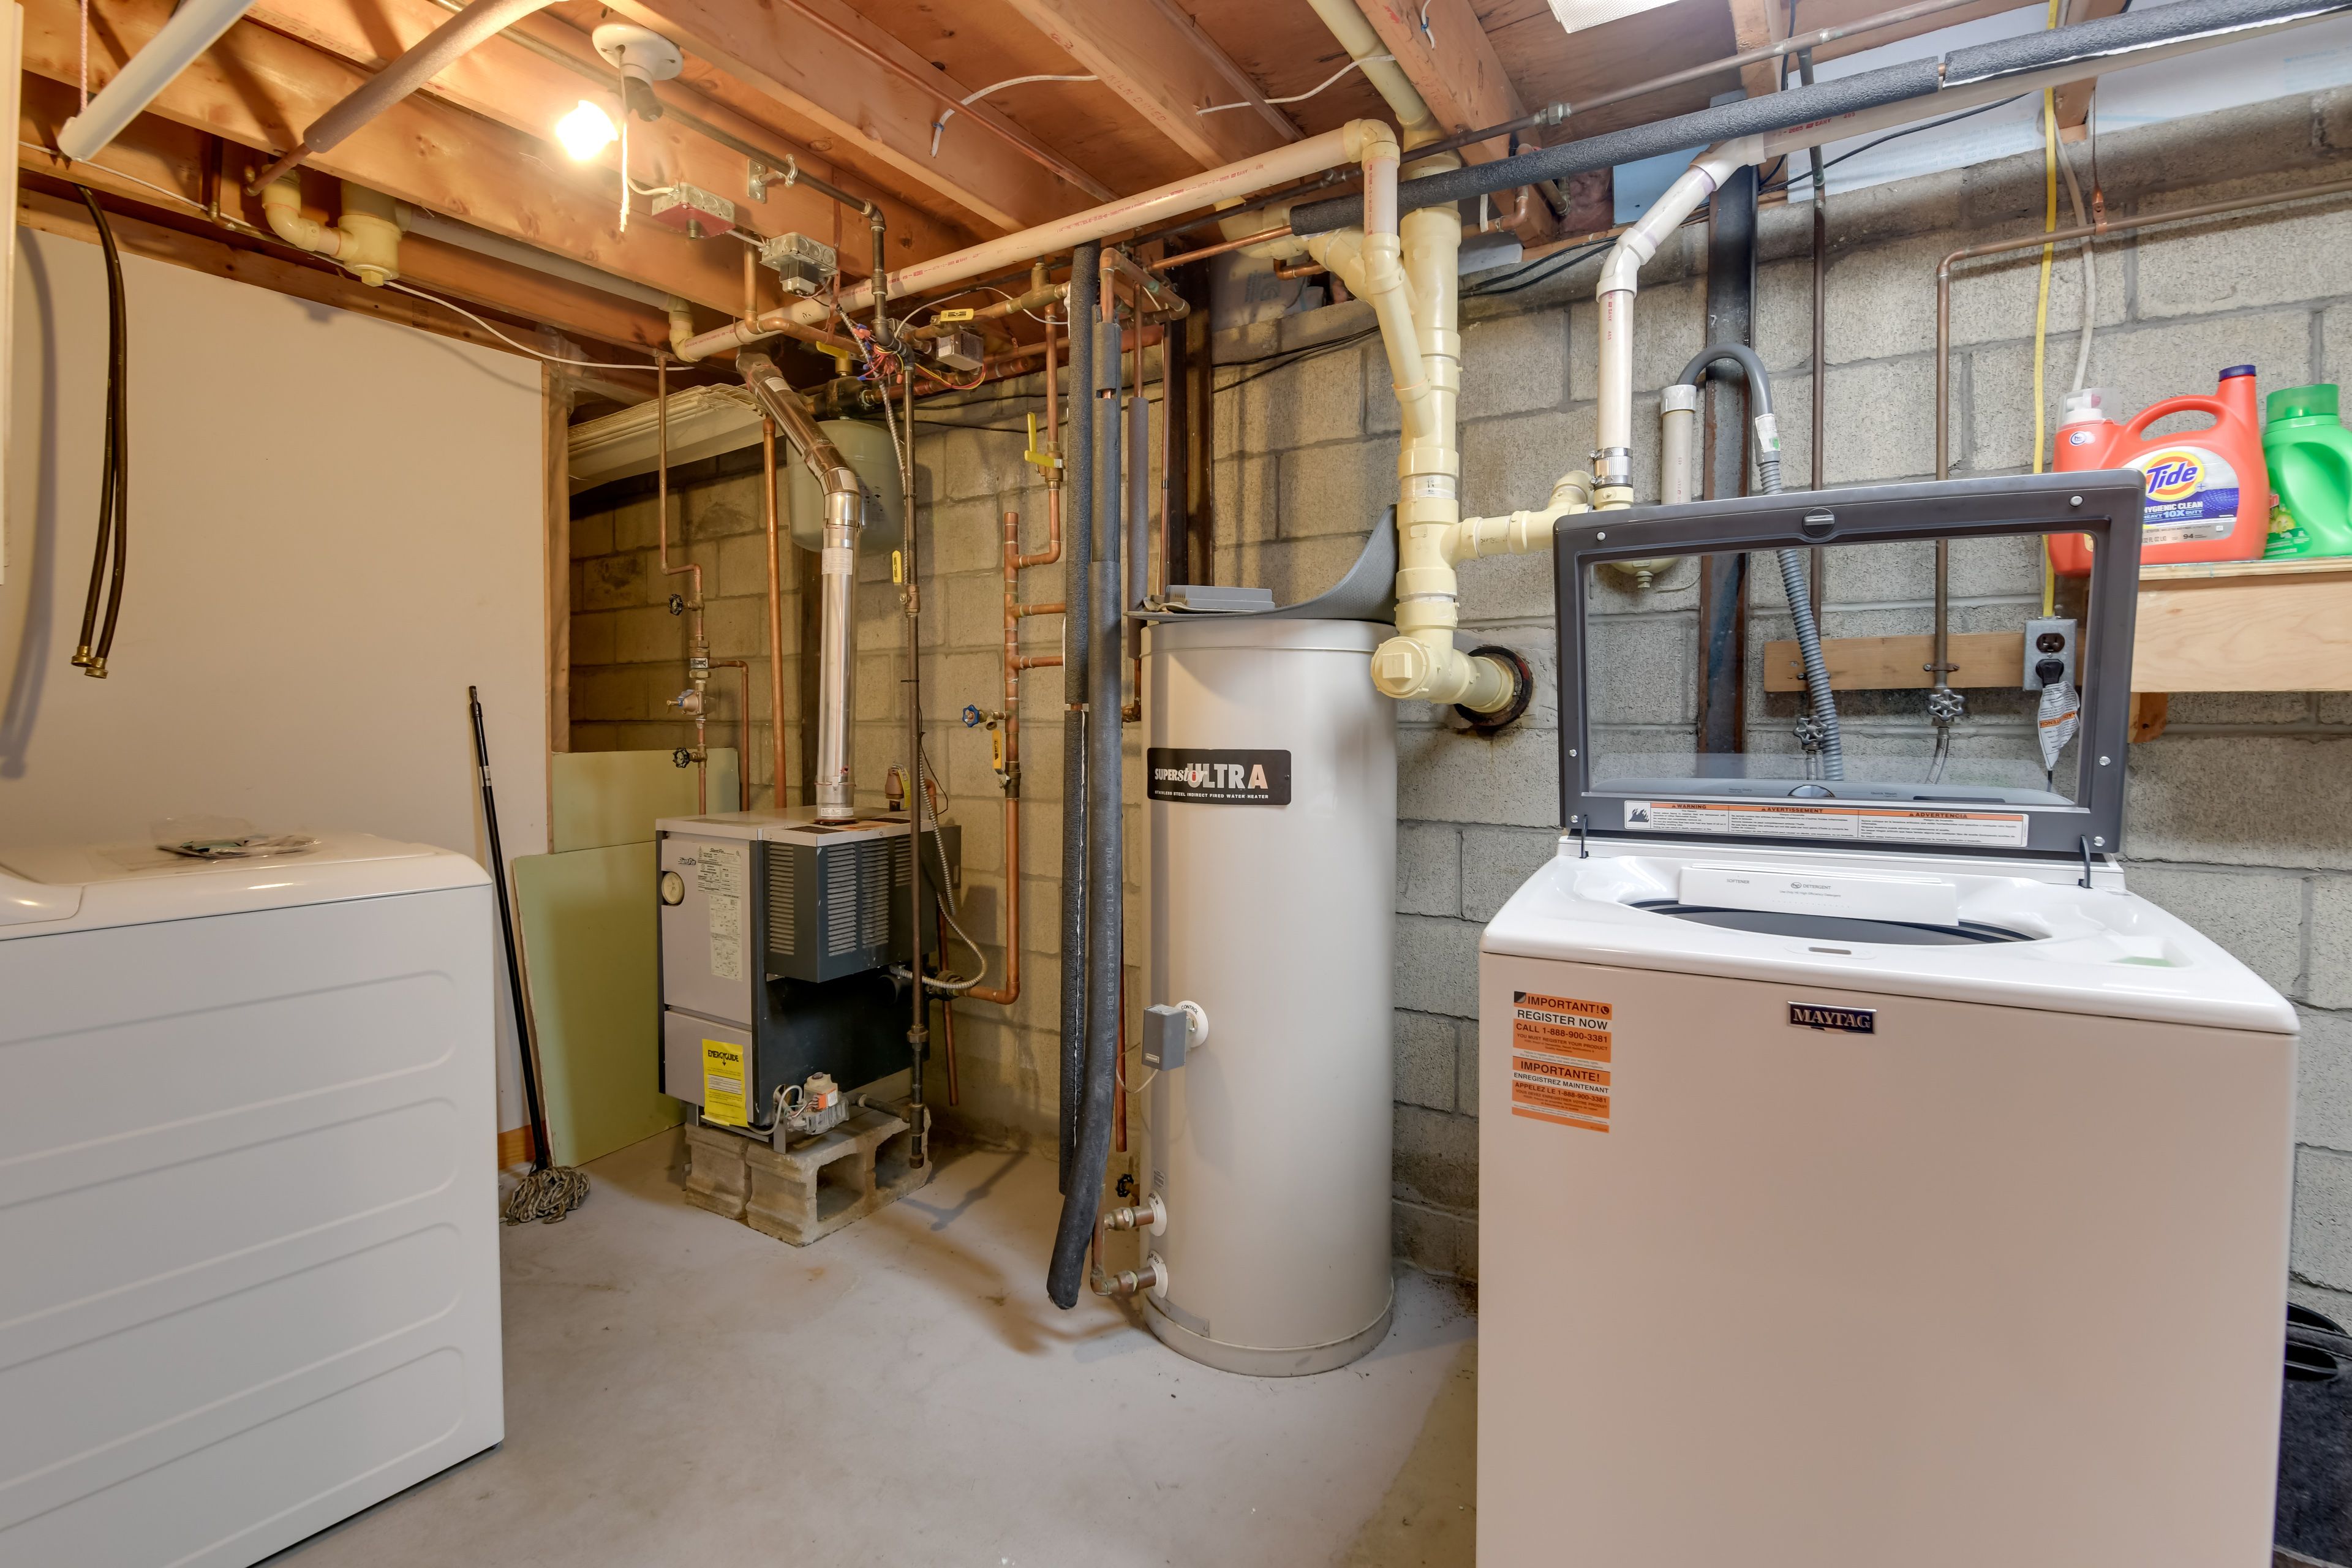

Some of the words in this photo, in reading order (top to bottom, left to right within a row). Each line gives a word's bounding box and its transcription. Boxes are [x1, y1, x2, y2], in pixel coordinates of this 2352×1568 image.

[2146, 461, 2198, 494] Tide
[1187, 763, 1268, 790] ULTRA
[1181, 1005, 1199, 1015] CONTROL
[1528, 996, 1599, 1014] IMPORTANT!
[1517, 1009, 1575, 1026] REGISTER
[1579, 1019, 1608, 1030] NOW
[1793, 1008, 1871, 1028] MAYTAG
[1517, 1023, 1539, 1033] CALL
[1543, 1028, 1607, 1042] 1-888-900-3381
[1521, 1061, 1600, 1082] IMPORTANTE!
[1513, 1072, 1561, 1085] ENREGISTREZ
[1562, 1081, 1609, 1094] MAINTENANT
[1515, 1082, 1545, 1093] APPELEZ
[1558, 1090, 1607, 1103] 1-888-900-3381
